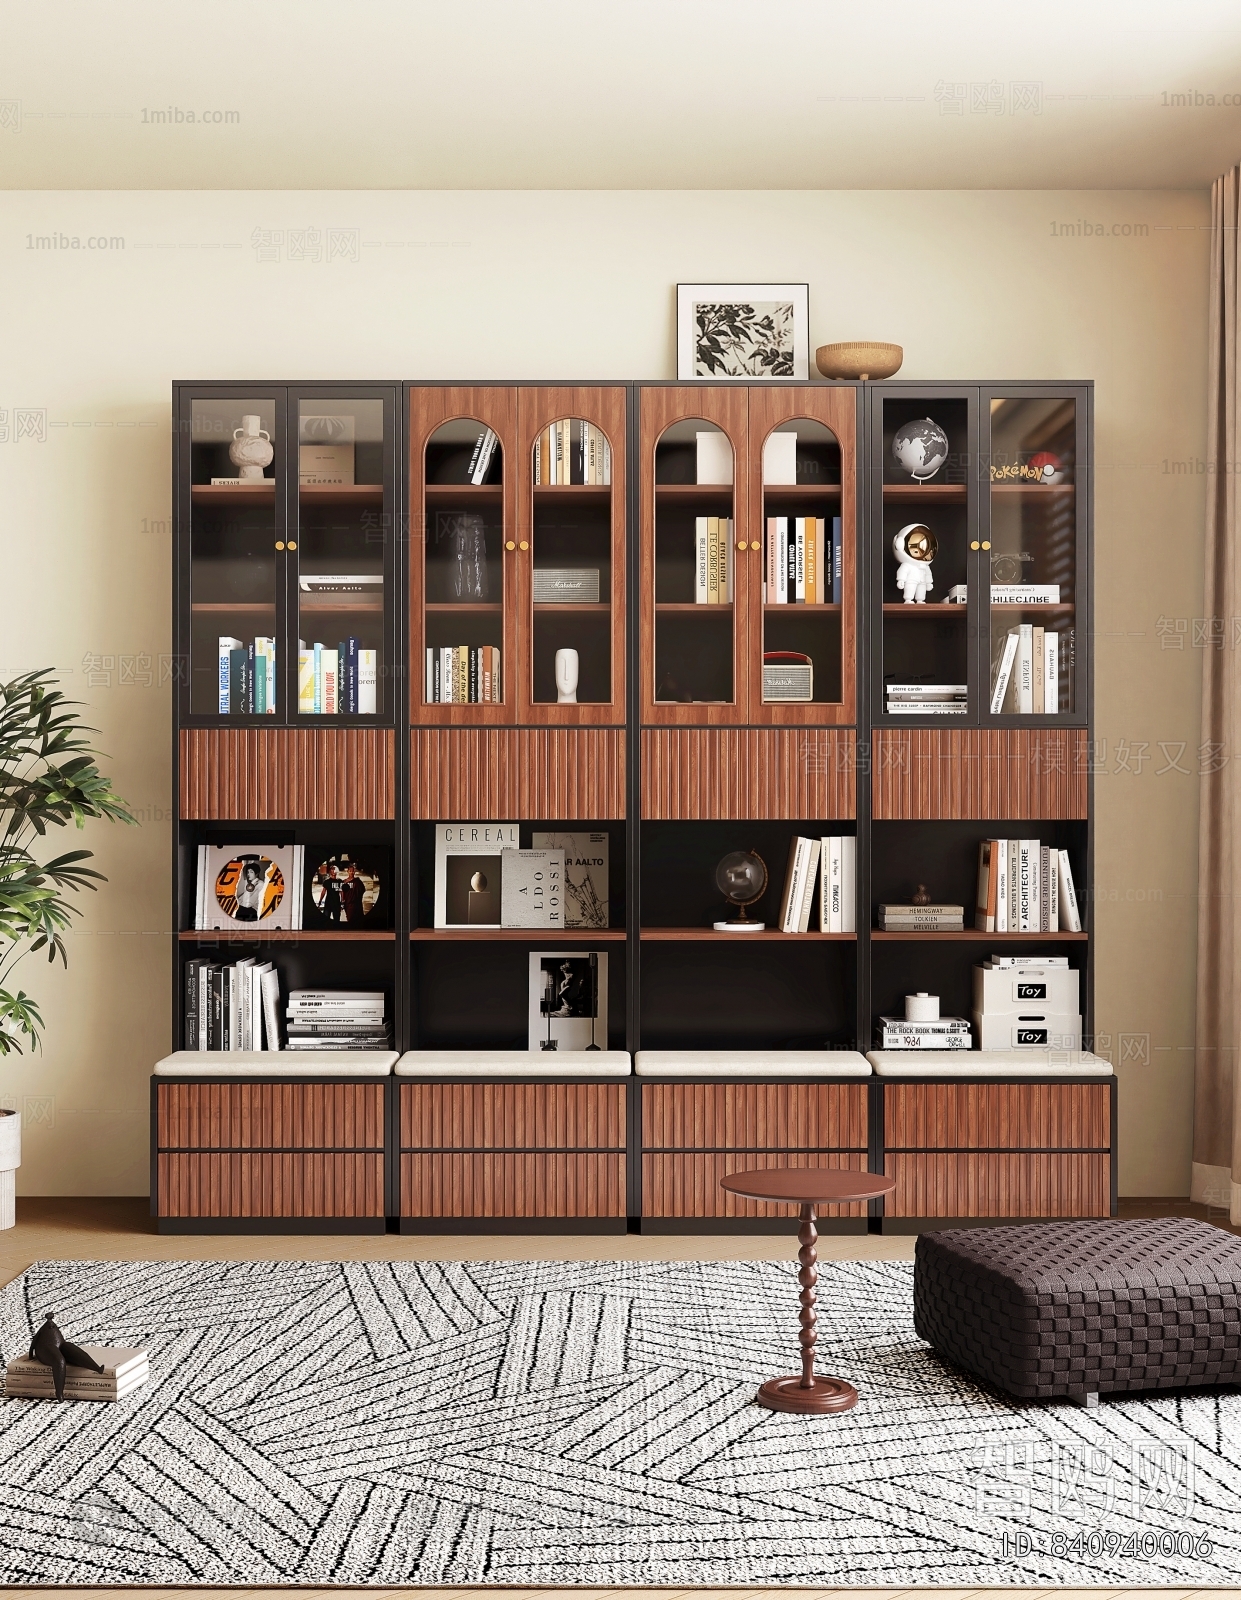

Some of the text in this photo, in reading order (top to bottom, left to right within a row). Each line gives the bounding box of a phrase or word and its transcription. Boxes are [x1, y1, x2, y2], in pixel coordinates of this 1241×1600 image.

[220, 657, 229, 690] WORKERS
[326, 672, 335, 685] LOVE
[326, 685, 335, 696] YOU
[446, 828, 516, 842] CEREAL
[575, 858, 604, 866] AALTO
[519, 886, 528, 896] A
[534, 871, 543, 910] LDO
[550, 860, 560, 920] ROSSI
[1018, 986, 1041, 997] Toy
[903, 1036, 920, 1046] 1984
[1018, 1031, 1042, 1042] Toy
